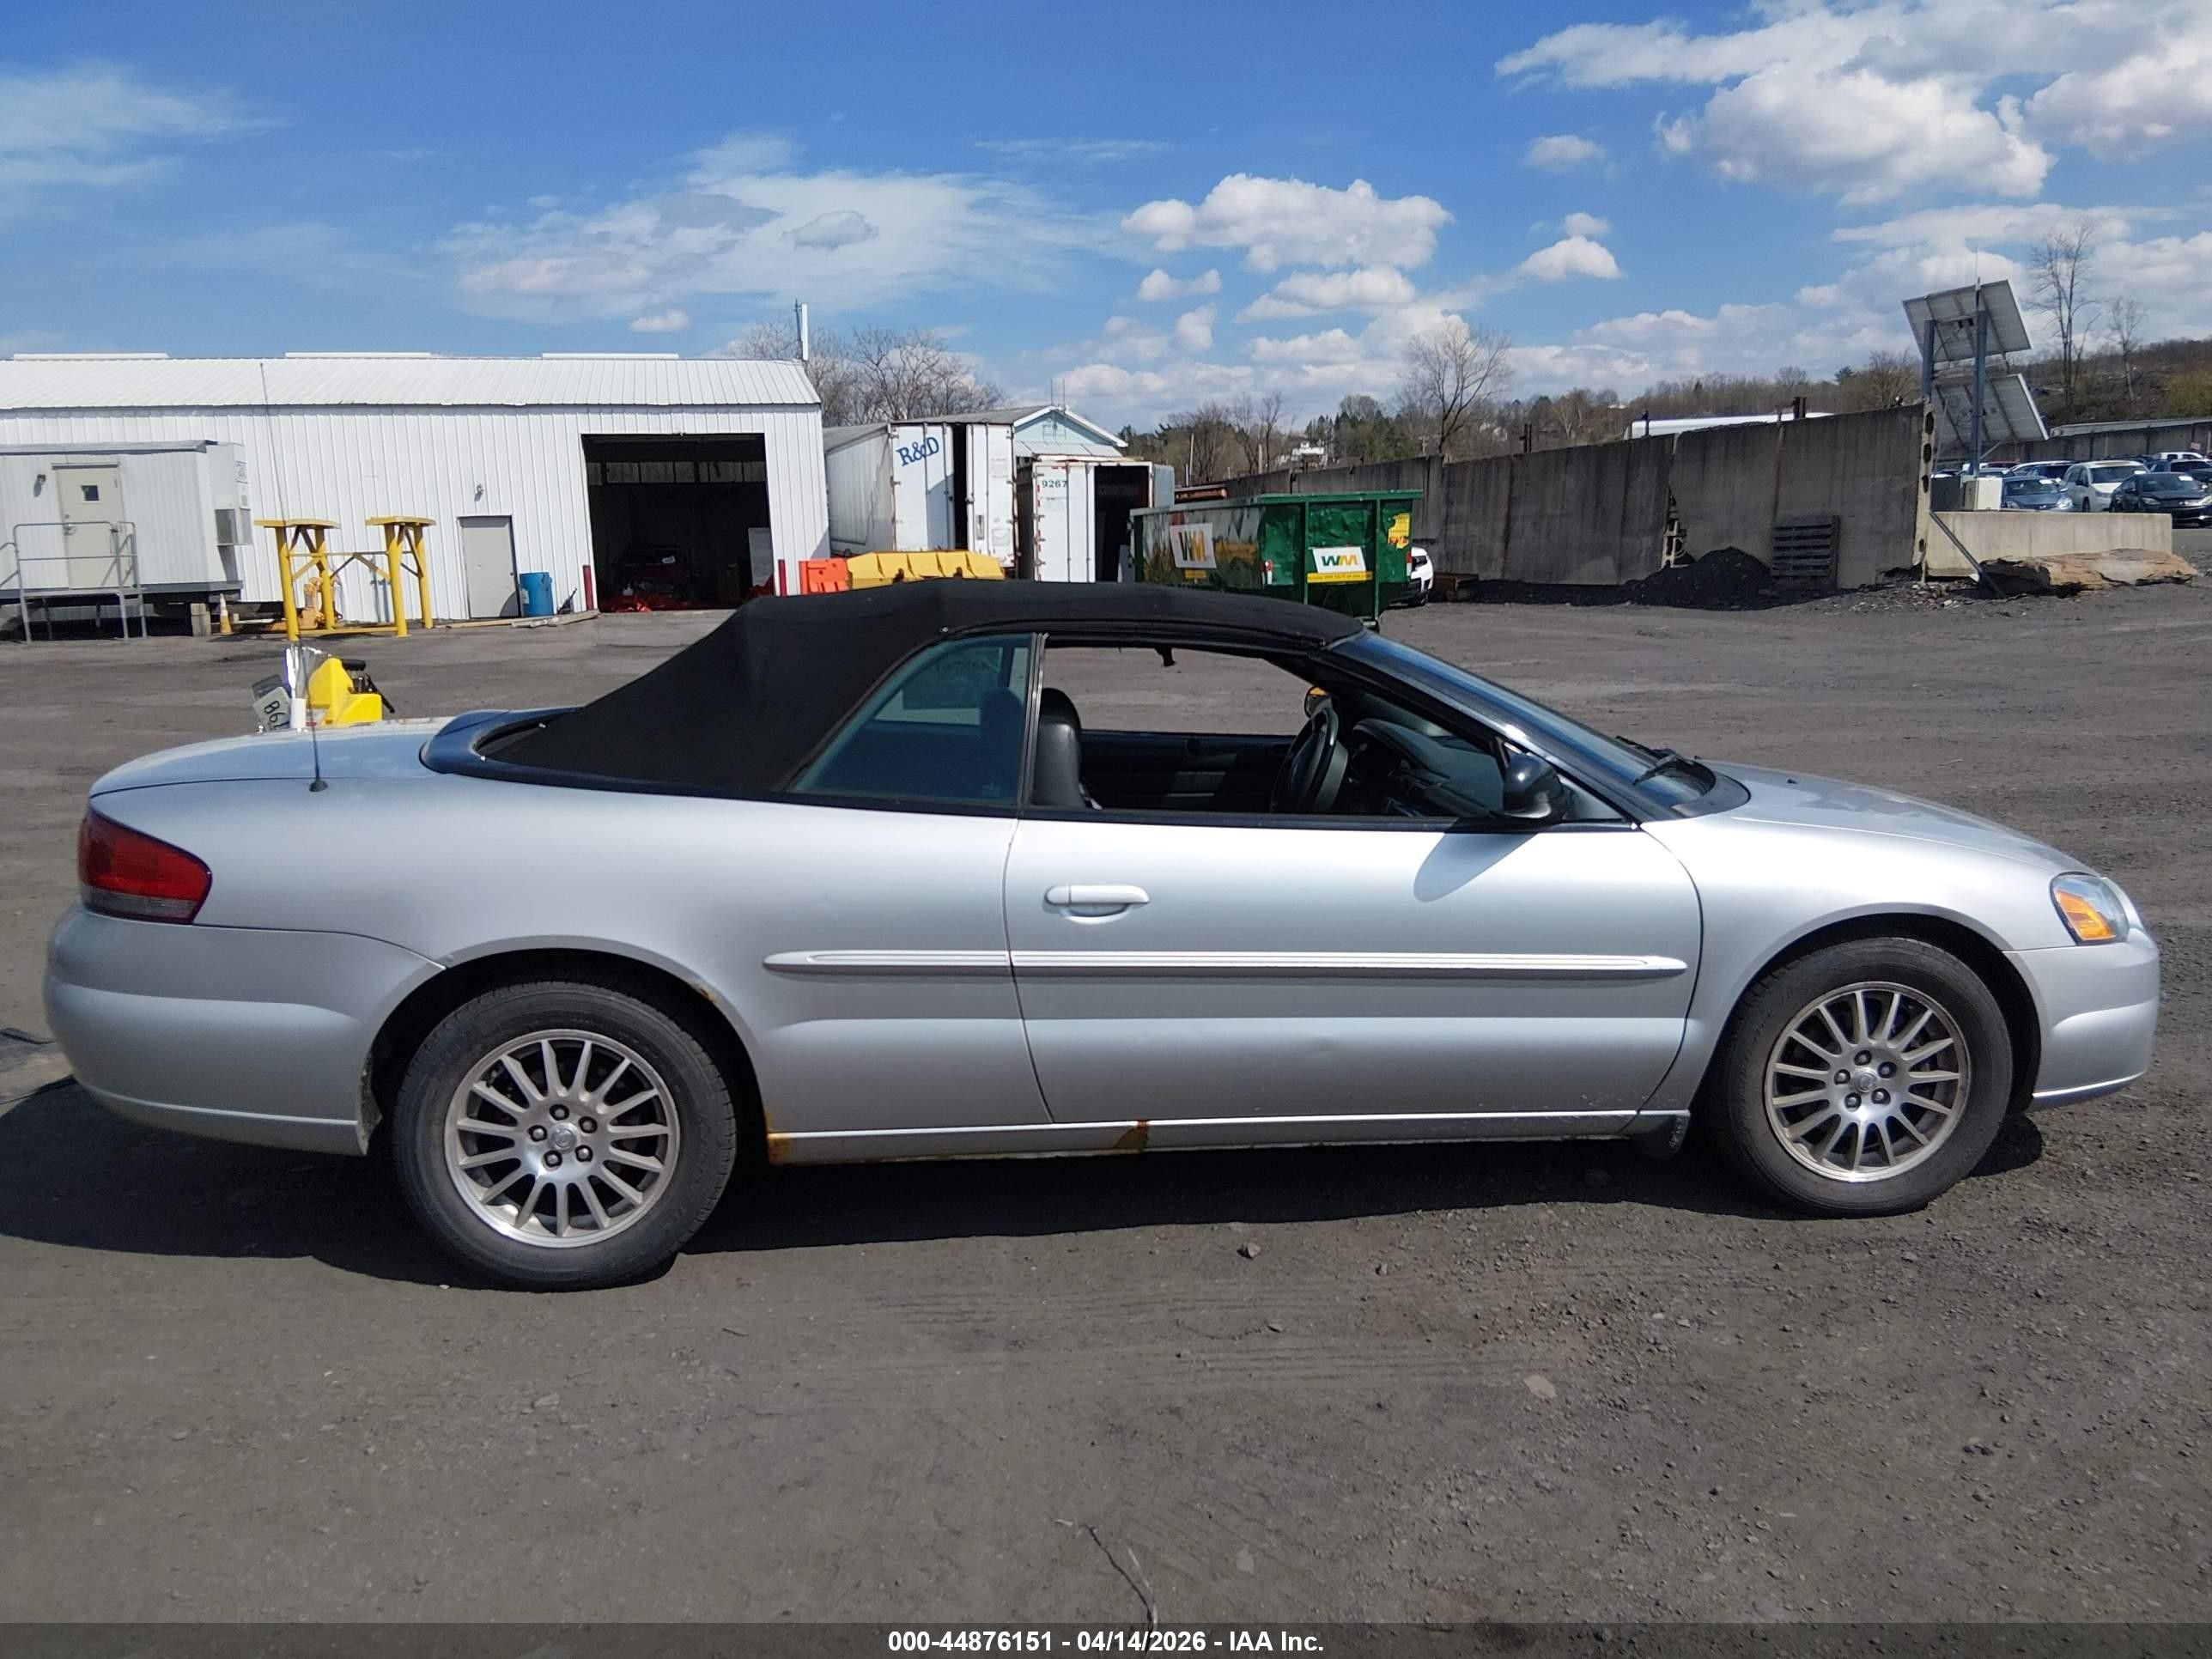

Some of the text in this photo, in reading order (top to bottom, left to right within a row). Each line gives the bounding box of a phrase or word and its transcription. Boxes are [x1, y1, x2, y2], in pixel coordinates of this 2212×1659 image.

[896, 437, 939, 466] R&D
[1042, 480, 1068, 489] 9267
[1178, 531, 1206, 561] WM
[1321, 555, 1358, 566] WM
